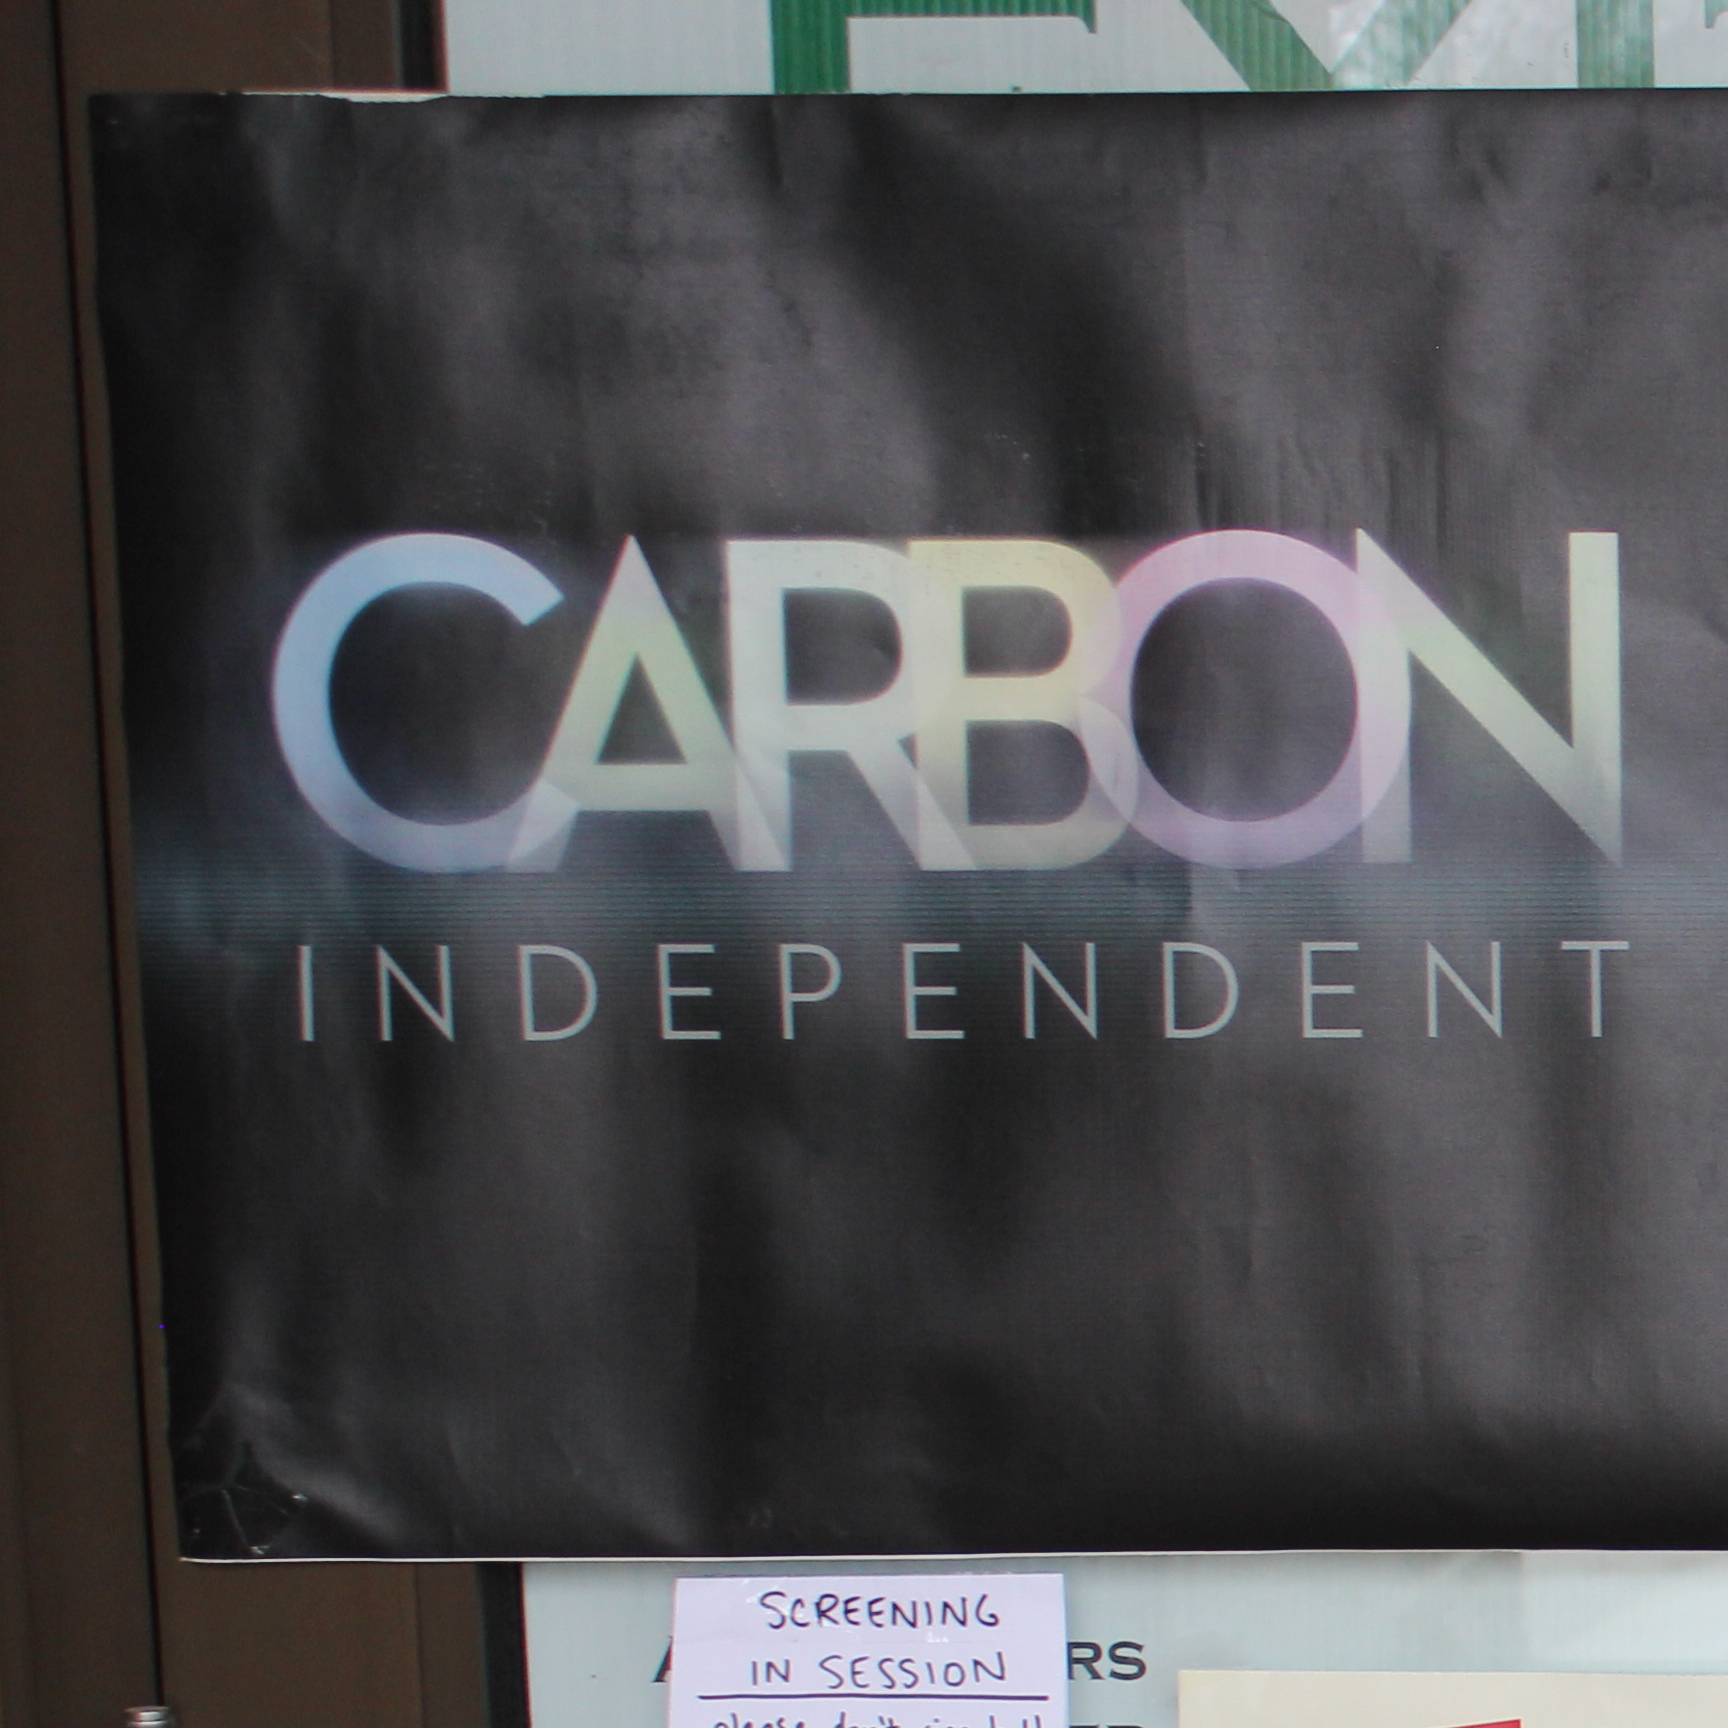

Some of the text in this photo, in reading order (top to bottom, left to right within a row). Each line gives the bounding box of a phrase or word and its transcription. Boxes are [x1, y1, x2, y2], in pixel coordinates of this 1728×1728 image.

[269, 525, 1627, 874] CARBON
[298, 942, 1634, 1046] INDEPENDENT
[759, 1591, 1001, 1630] SCREENING
[751, 1651, 1007, 1691] IN SESSION
